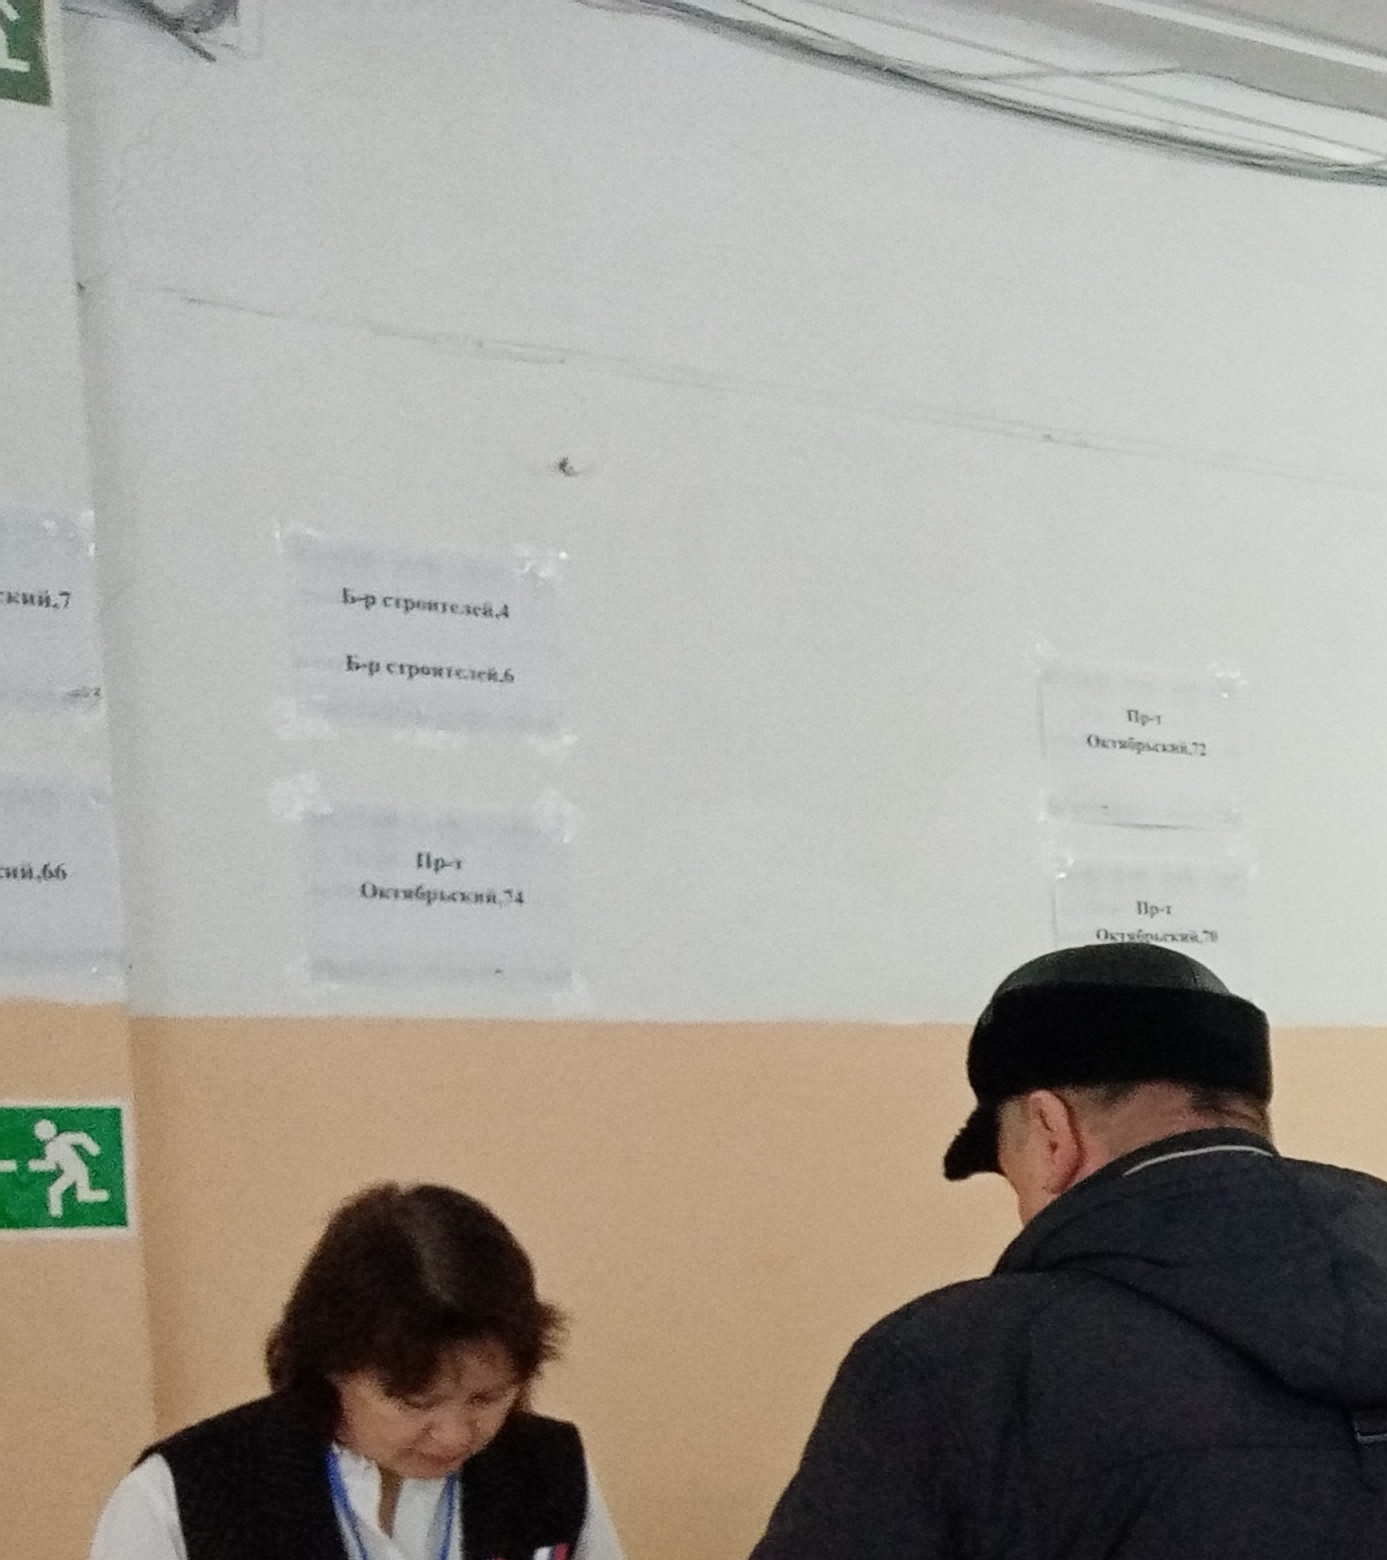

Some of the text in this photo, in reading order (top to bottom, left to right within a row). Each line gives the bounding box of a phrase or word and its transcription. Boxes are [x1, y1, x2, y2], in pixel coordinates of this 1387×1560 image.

[342, 587, 377, 612] Б-р
[346, 654, 381, 677] Б-р
[1127, 709, 1162, 727] Пр-т
[416, 851, 463, 875] Пр-т
[1136, 900, 1174, 919] Пр-т
